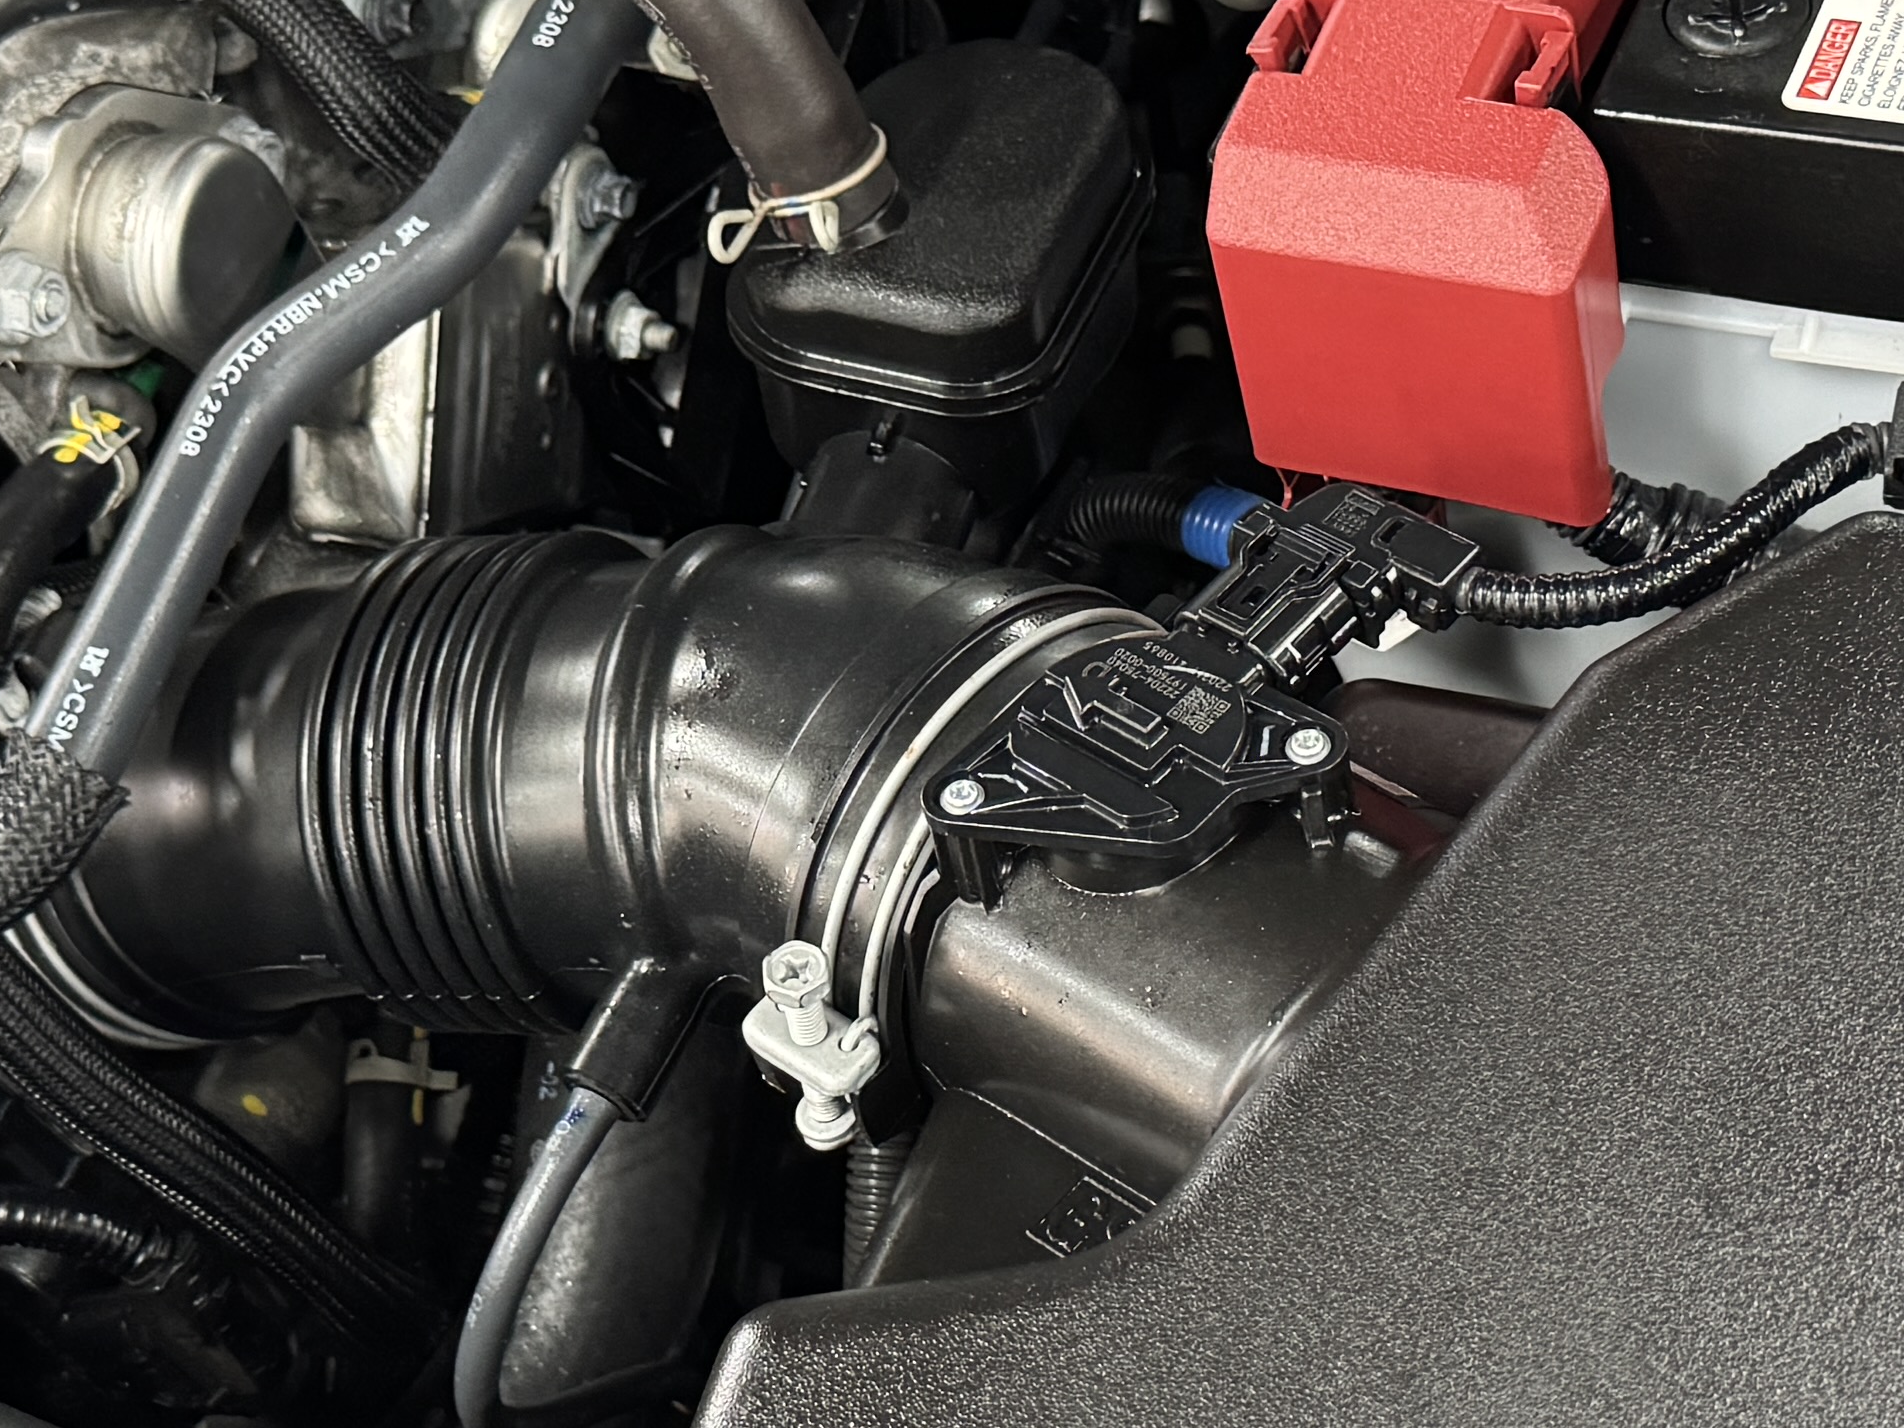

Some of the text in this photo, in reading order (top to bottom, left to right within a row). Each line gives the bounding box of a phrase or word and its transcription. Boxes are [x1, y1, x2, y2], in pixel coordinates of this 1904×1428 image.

[1812, 22, 1858, 80] DANGER
[1838, 77, 1857, 104] KEEP
[1850, 35, 1879, 75] SPARKS,
[1857, 43, 1895, 106] CIGARETTES
